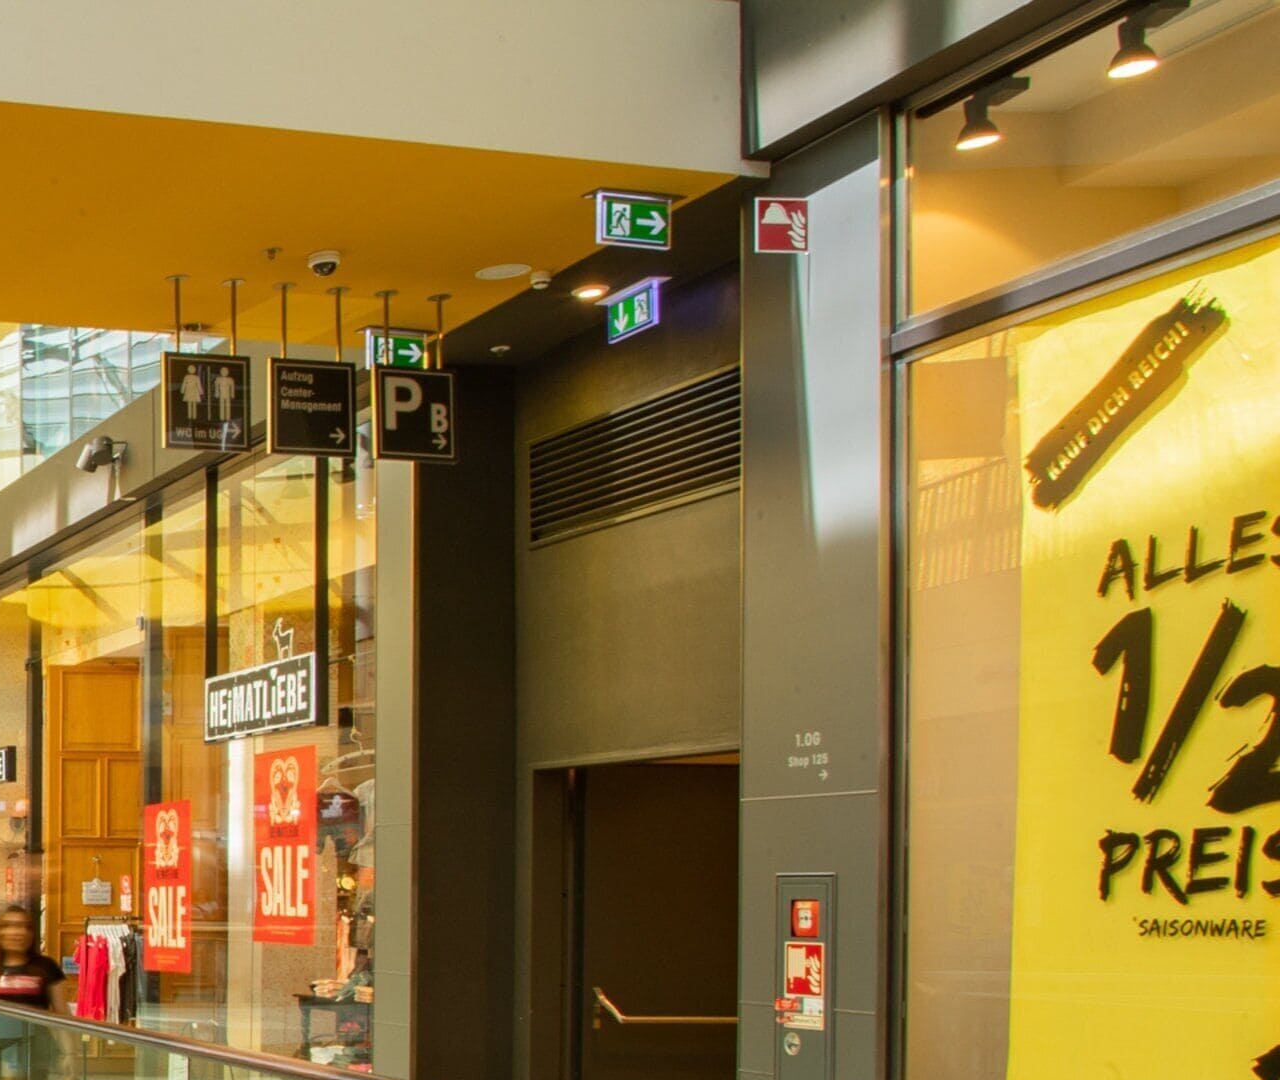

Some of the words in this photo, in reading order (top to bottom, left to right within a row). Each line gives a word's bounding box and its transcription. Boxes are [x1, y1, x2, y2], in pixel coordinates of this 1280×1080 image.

[280, 370, 314, 384] Aufzug
[280, 387, 316, 399] Center-
[384, 376, 423, 431] P
[1046, 432, 1088, 480] KAUF
[1086, 386, 1131, 440] DICH
[1129, 320, 1190, 393] REICH!
[280, 400, 342, 413] Management
[430, 402, 449, 434] B
[175, 426, 193, 439] WC
[194, 429, 207, 439] im
[787, 756, 810, 768] Shop
[812, 752, 829, 765] 125
[260, 845, 309, 918] SALE
[148, 886, 187, 949] SALE
